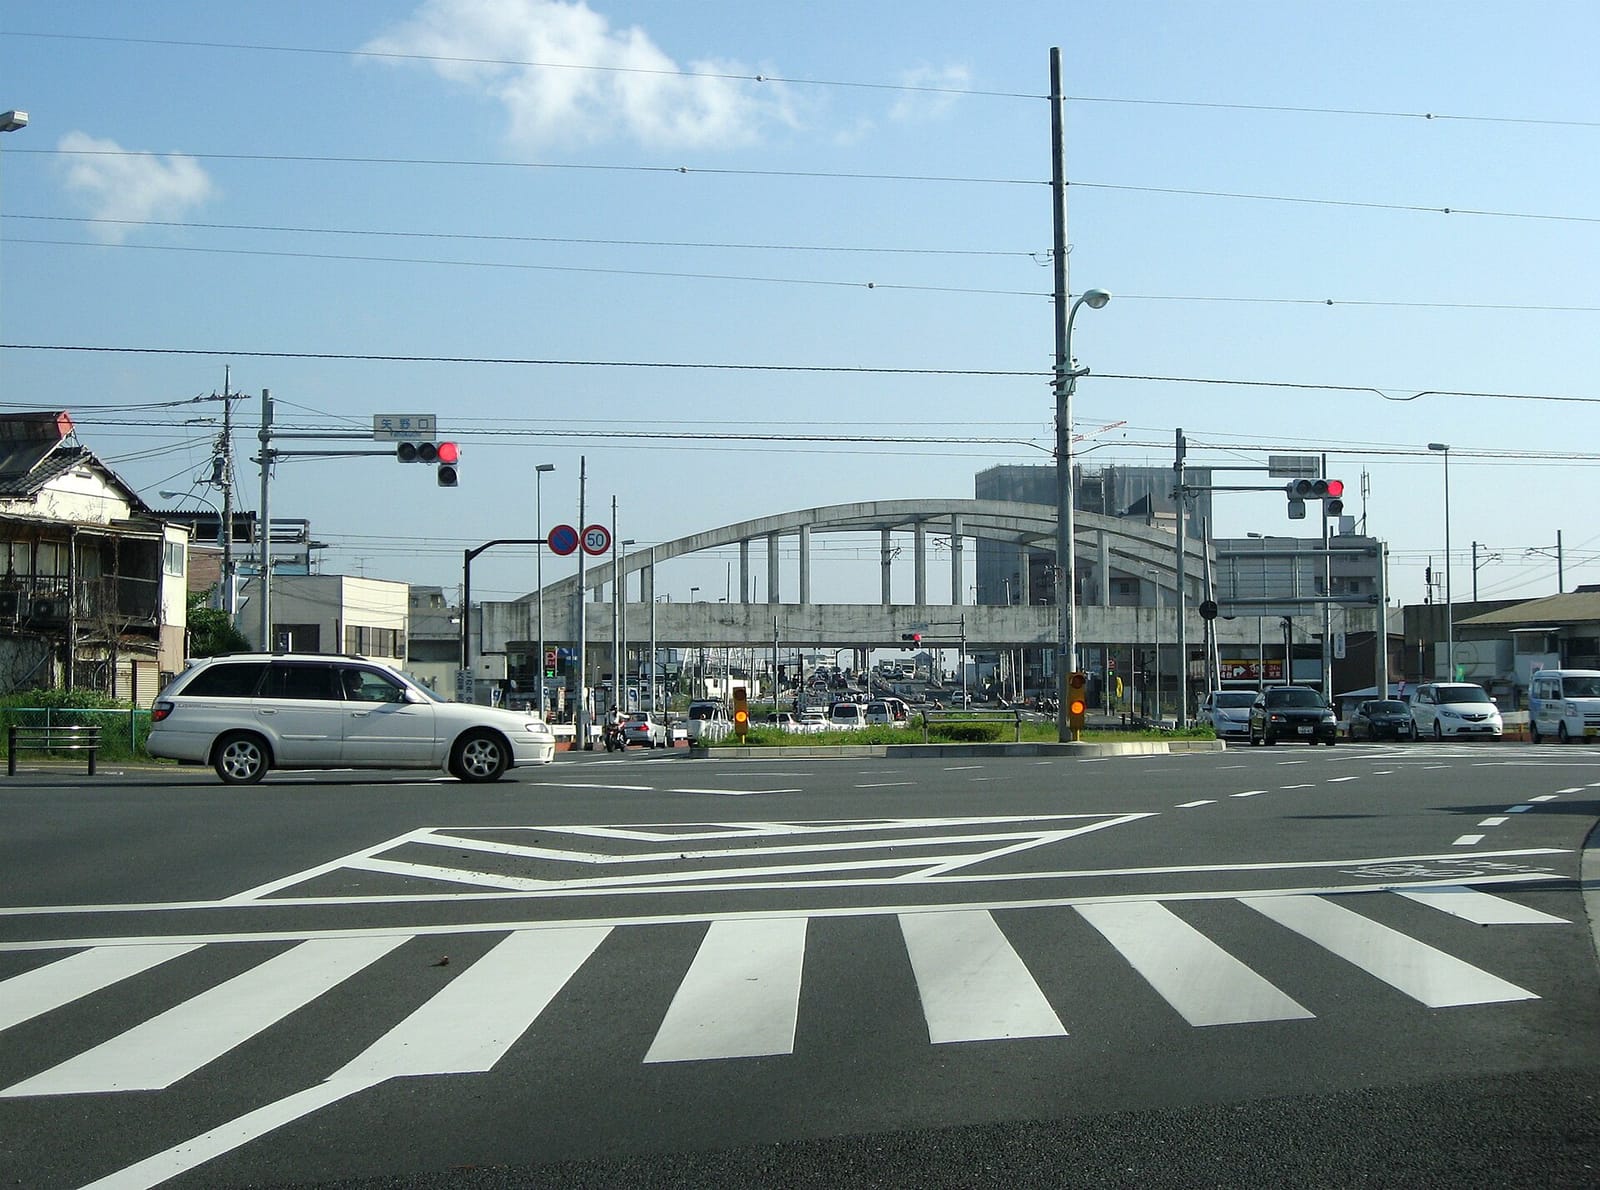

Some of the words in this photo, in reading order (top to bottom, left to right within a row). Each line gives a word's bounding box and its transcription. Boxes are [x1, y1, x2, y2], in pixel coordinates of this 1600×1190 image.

[381, 418, 429, 430] 矢野口
[587, 533, 604, 547] 50
